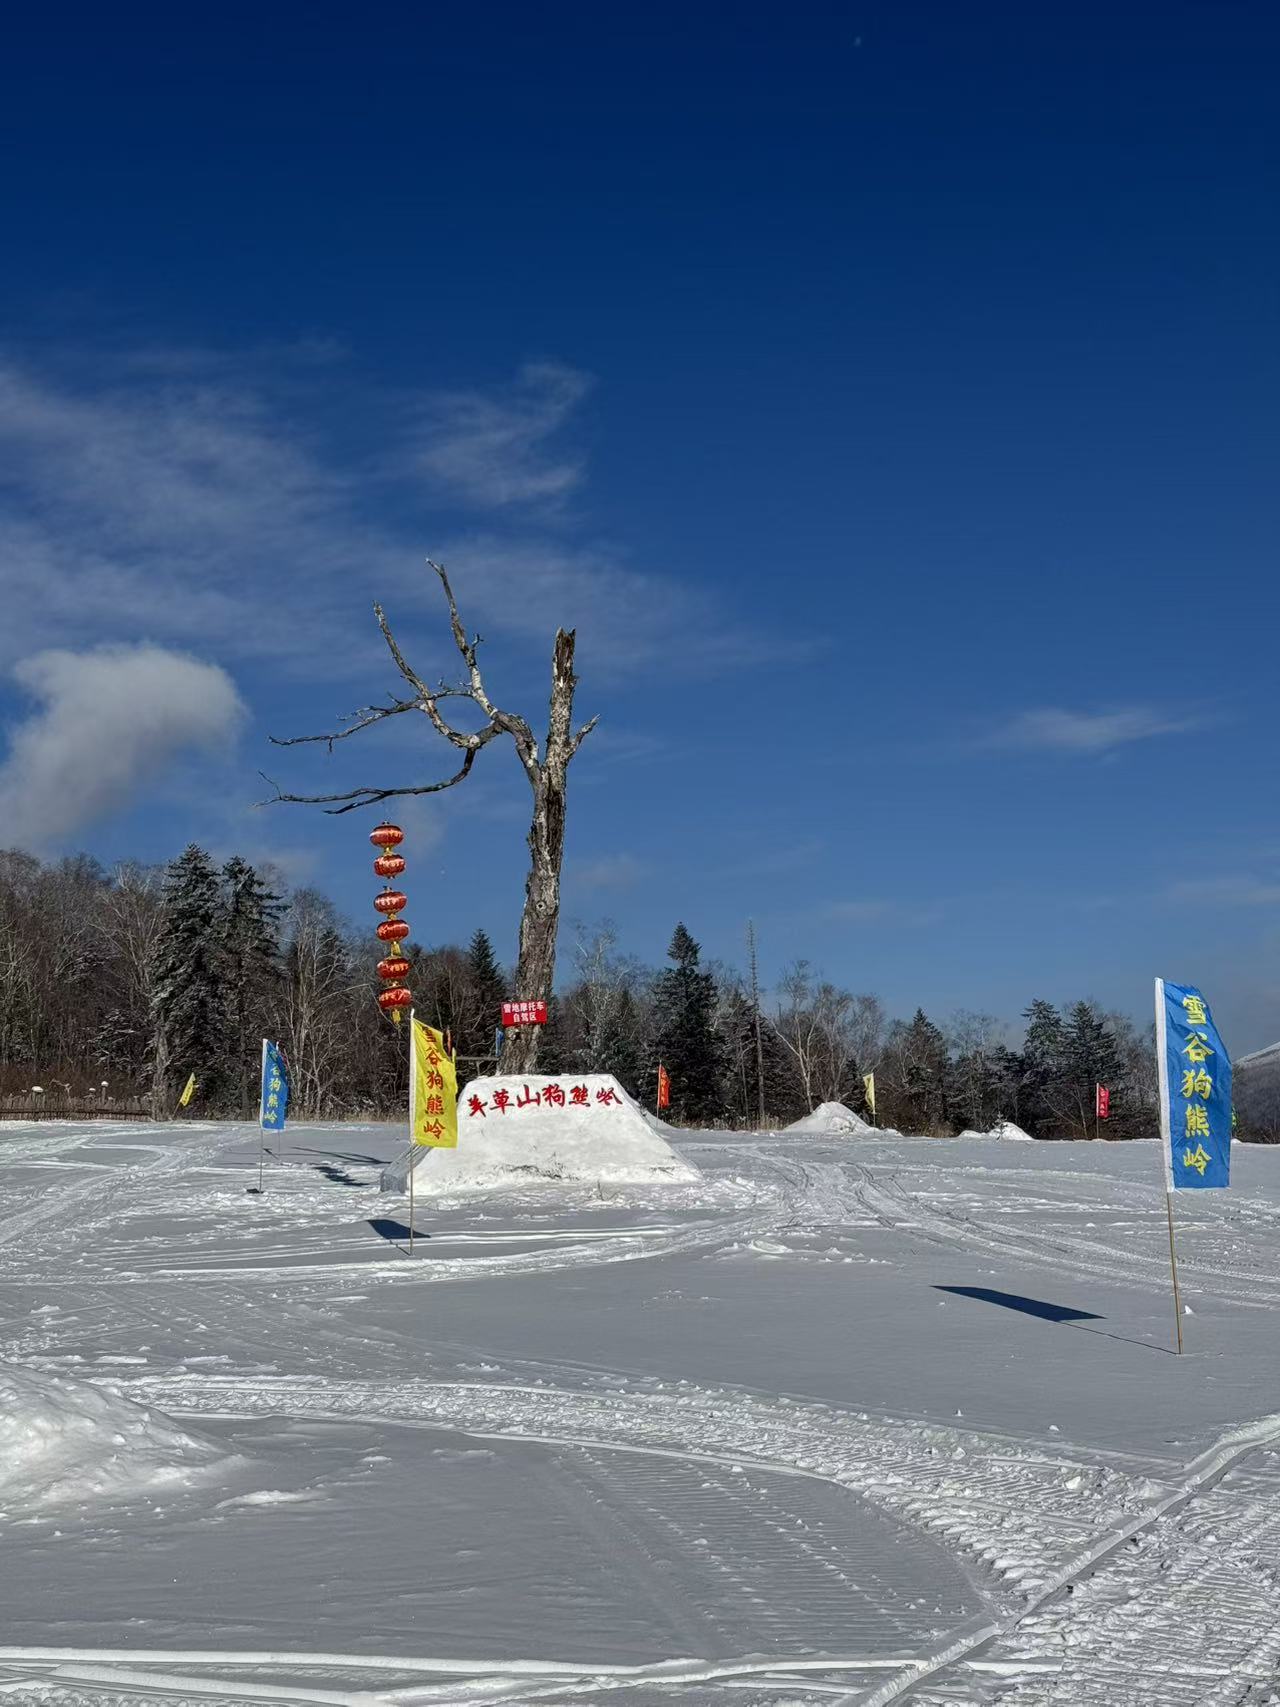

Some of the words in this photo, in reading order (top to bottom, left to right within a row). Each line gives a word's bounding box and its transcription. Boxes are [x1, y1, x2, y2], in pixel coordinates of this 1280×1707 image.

[503, 1001, 545, 1013] 雪地摩托车
[513, 1011, 537, 1023] 自驾区
[1180, 994, 1215, 1176] 雪谷狗熊岭
